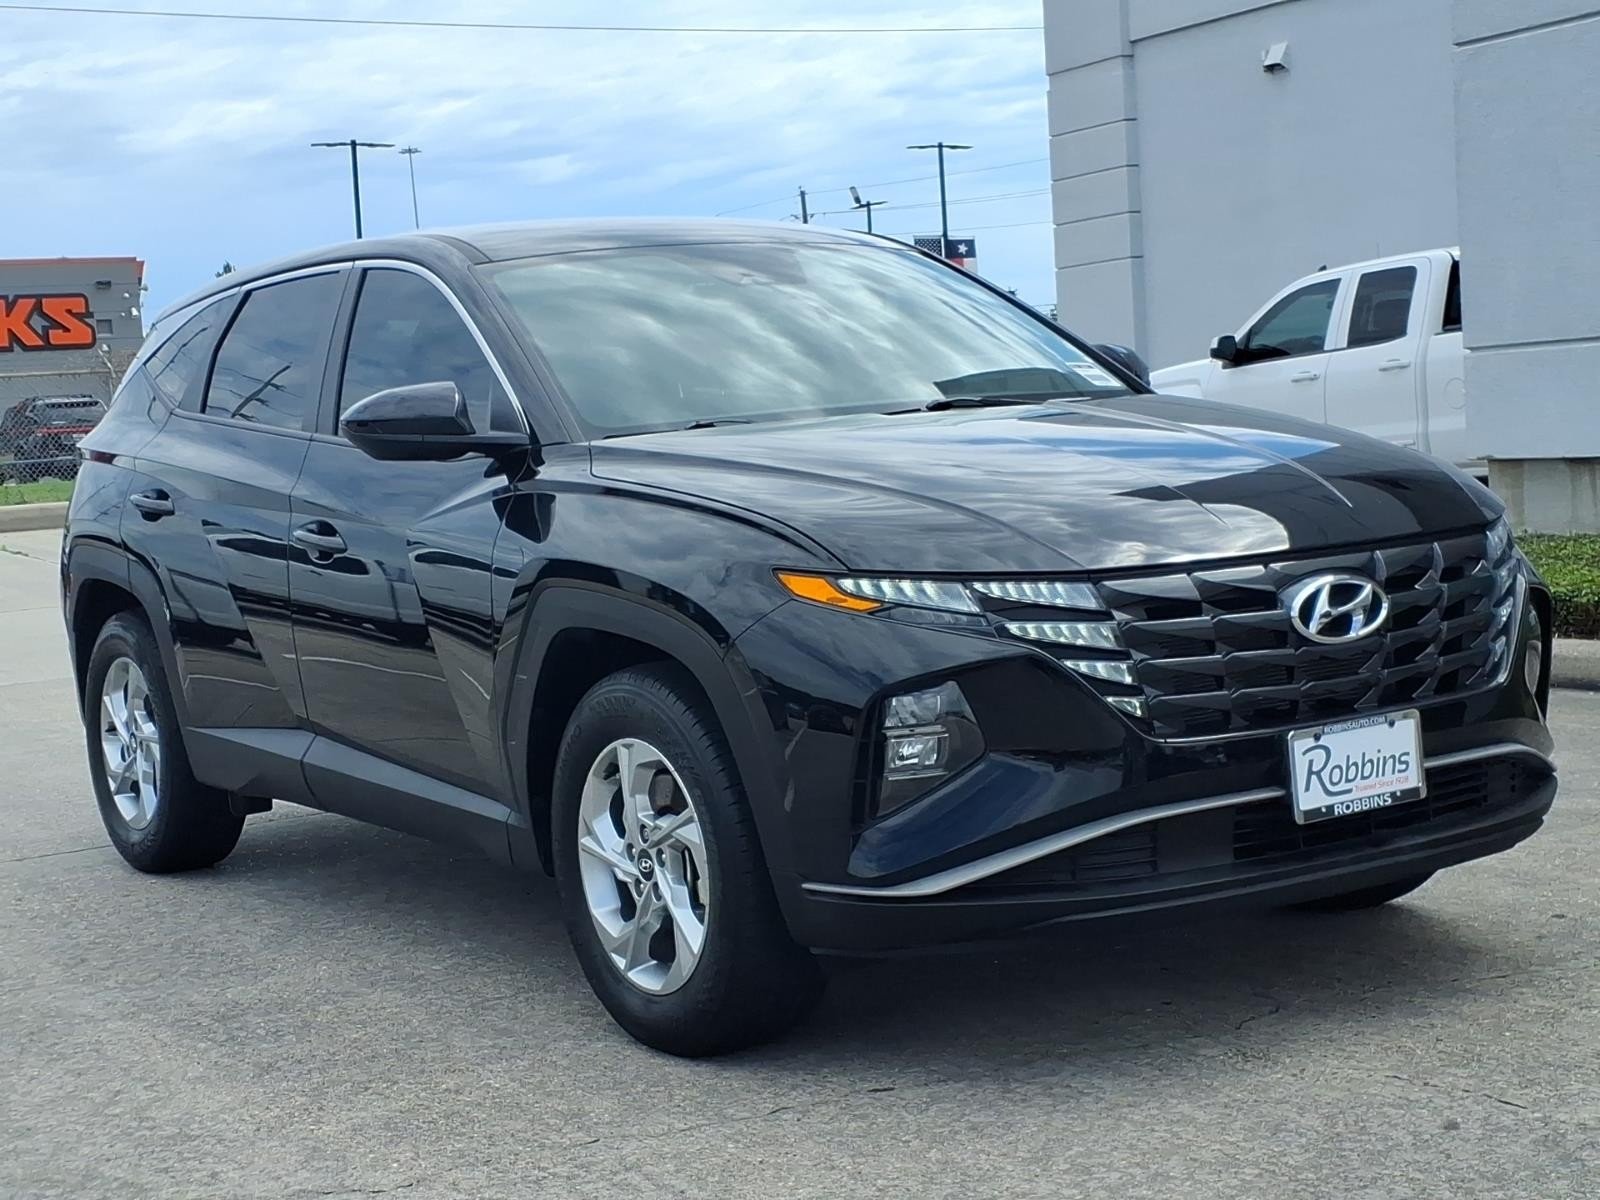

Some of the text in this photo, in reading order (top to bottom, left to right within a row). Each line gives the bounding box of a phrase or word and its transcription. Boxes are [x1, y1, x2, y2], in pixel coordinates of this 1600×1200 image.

[0, 294, 95, 350] KS
[1302, 744, 1410, 797] Robbins
[1333, 793, 1392, 816] ROBBINS
